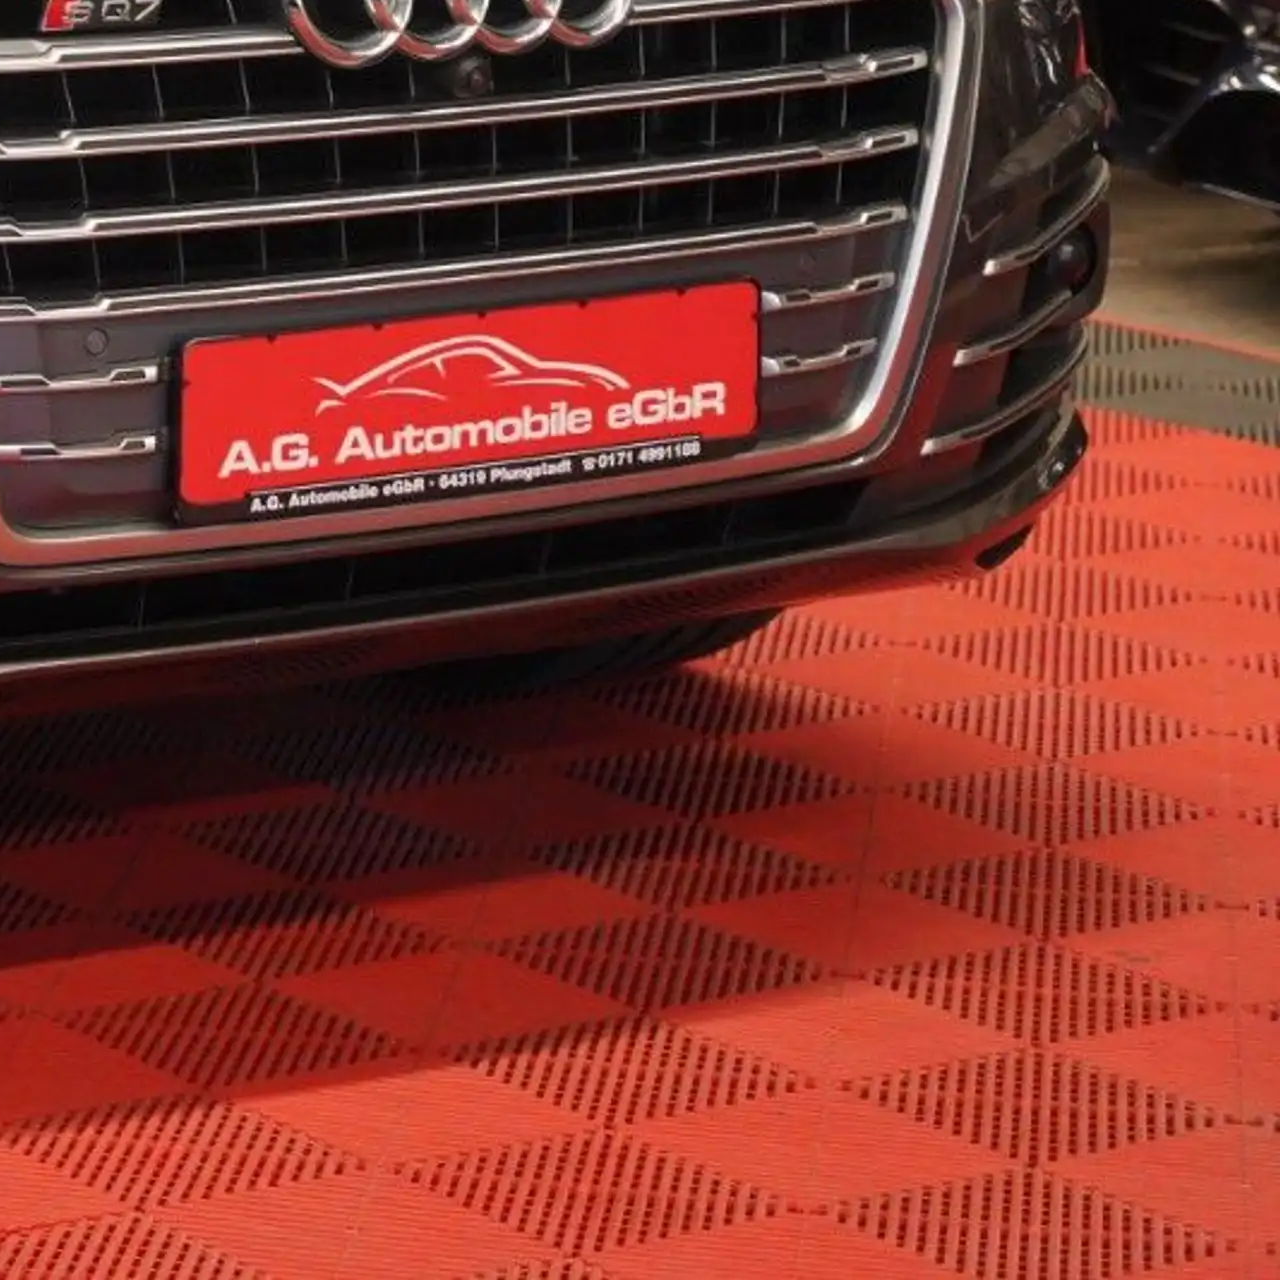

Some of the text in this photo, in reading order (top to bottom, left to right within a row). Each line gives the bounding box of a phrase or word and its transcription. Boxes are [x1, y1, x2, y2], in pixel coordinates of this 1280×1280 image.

[218, 382, 726, 479] A.G. Automobile eGbR
[288, 485, 378, 509] Automobile
[382, 477, 426, 497] eGbR
[598, 450, 633, 469] 0171
